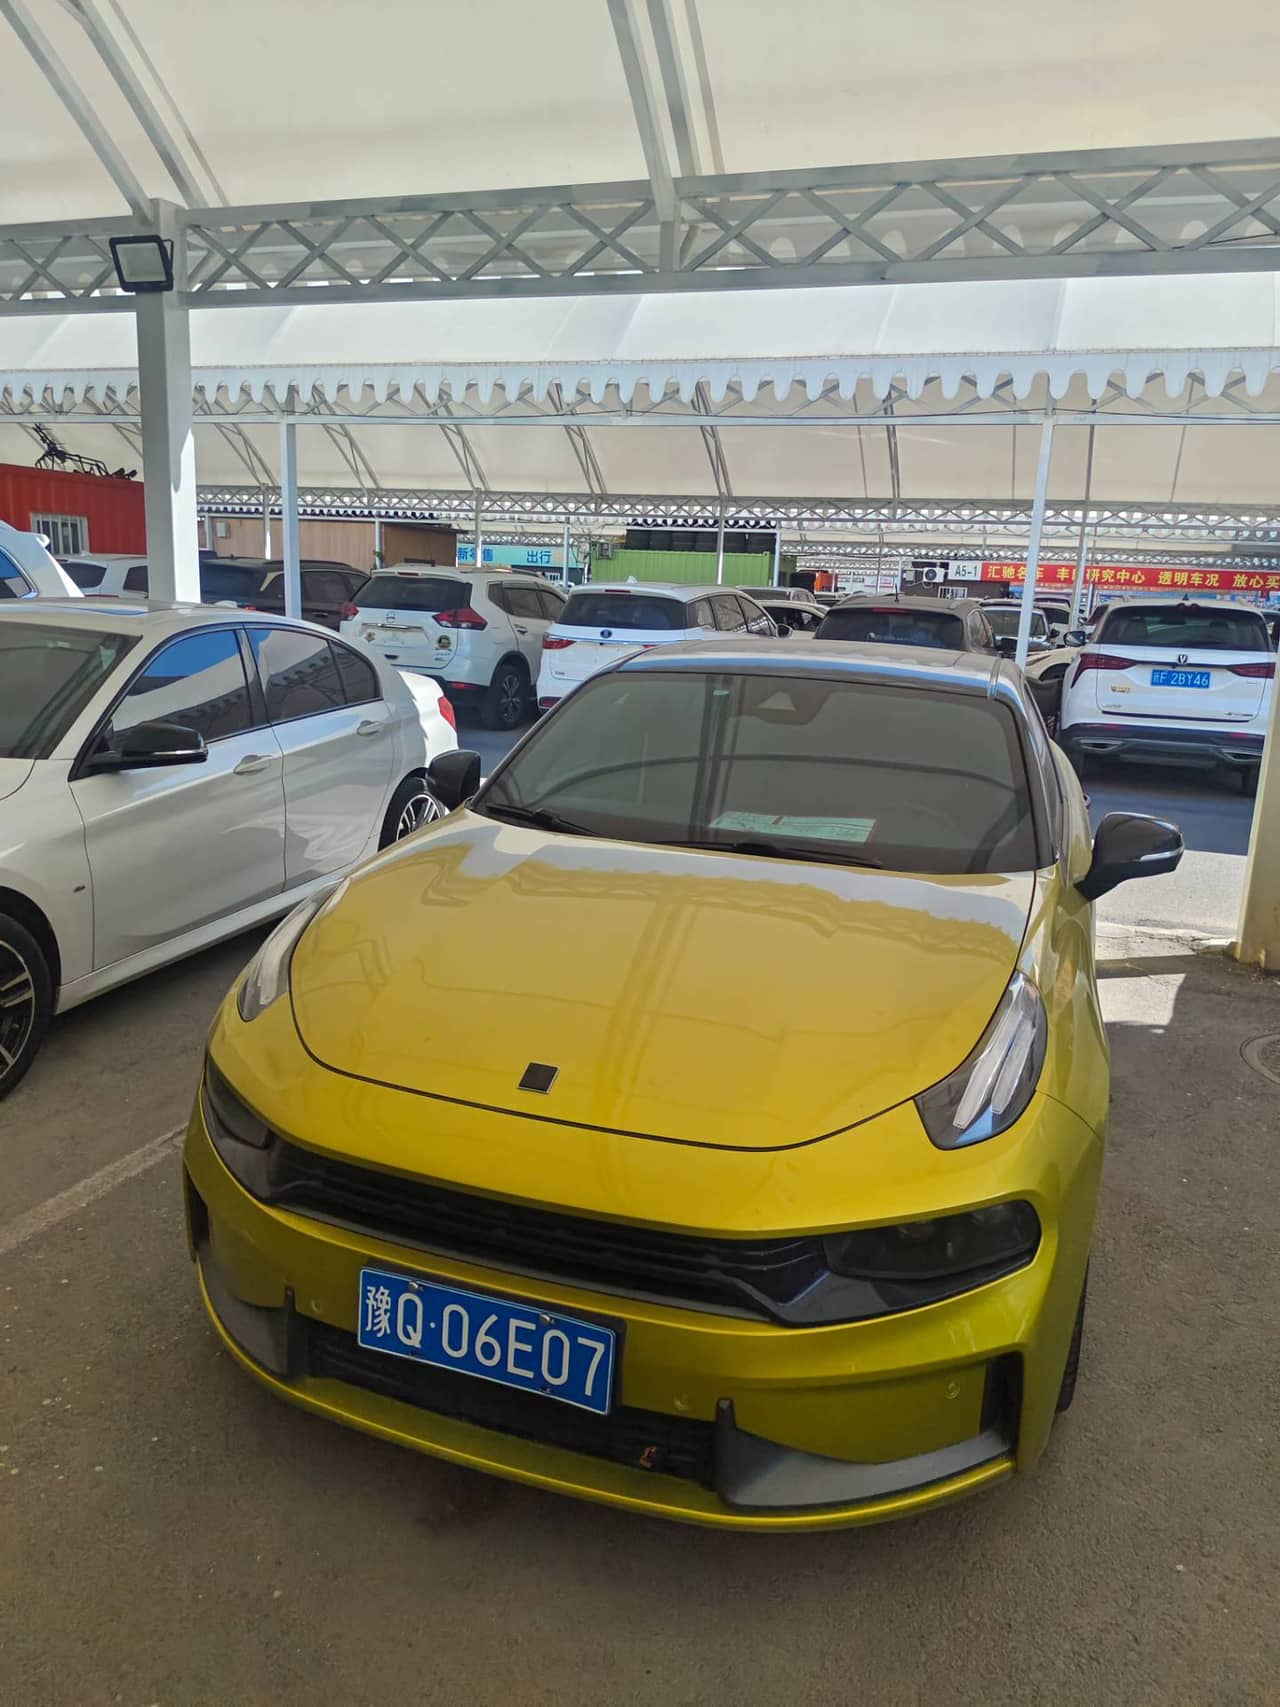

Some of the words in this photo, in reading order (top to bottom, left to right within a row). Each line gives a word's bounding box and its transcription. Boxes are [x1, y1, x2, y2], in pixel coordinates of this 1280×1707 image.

[526, 549, 552, 564] 出行
[954, 564, 977, 577] A5-1
[1056, 567, 1145, 584] 丰研究中心
[1157, 571, 1220, 586] 透明车况
